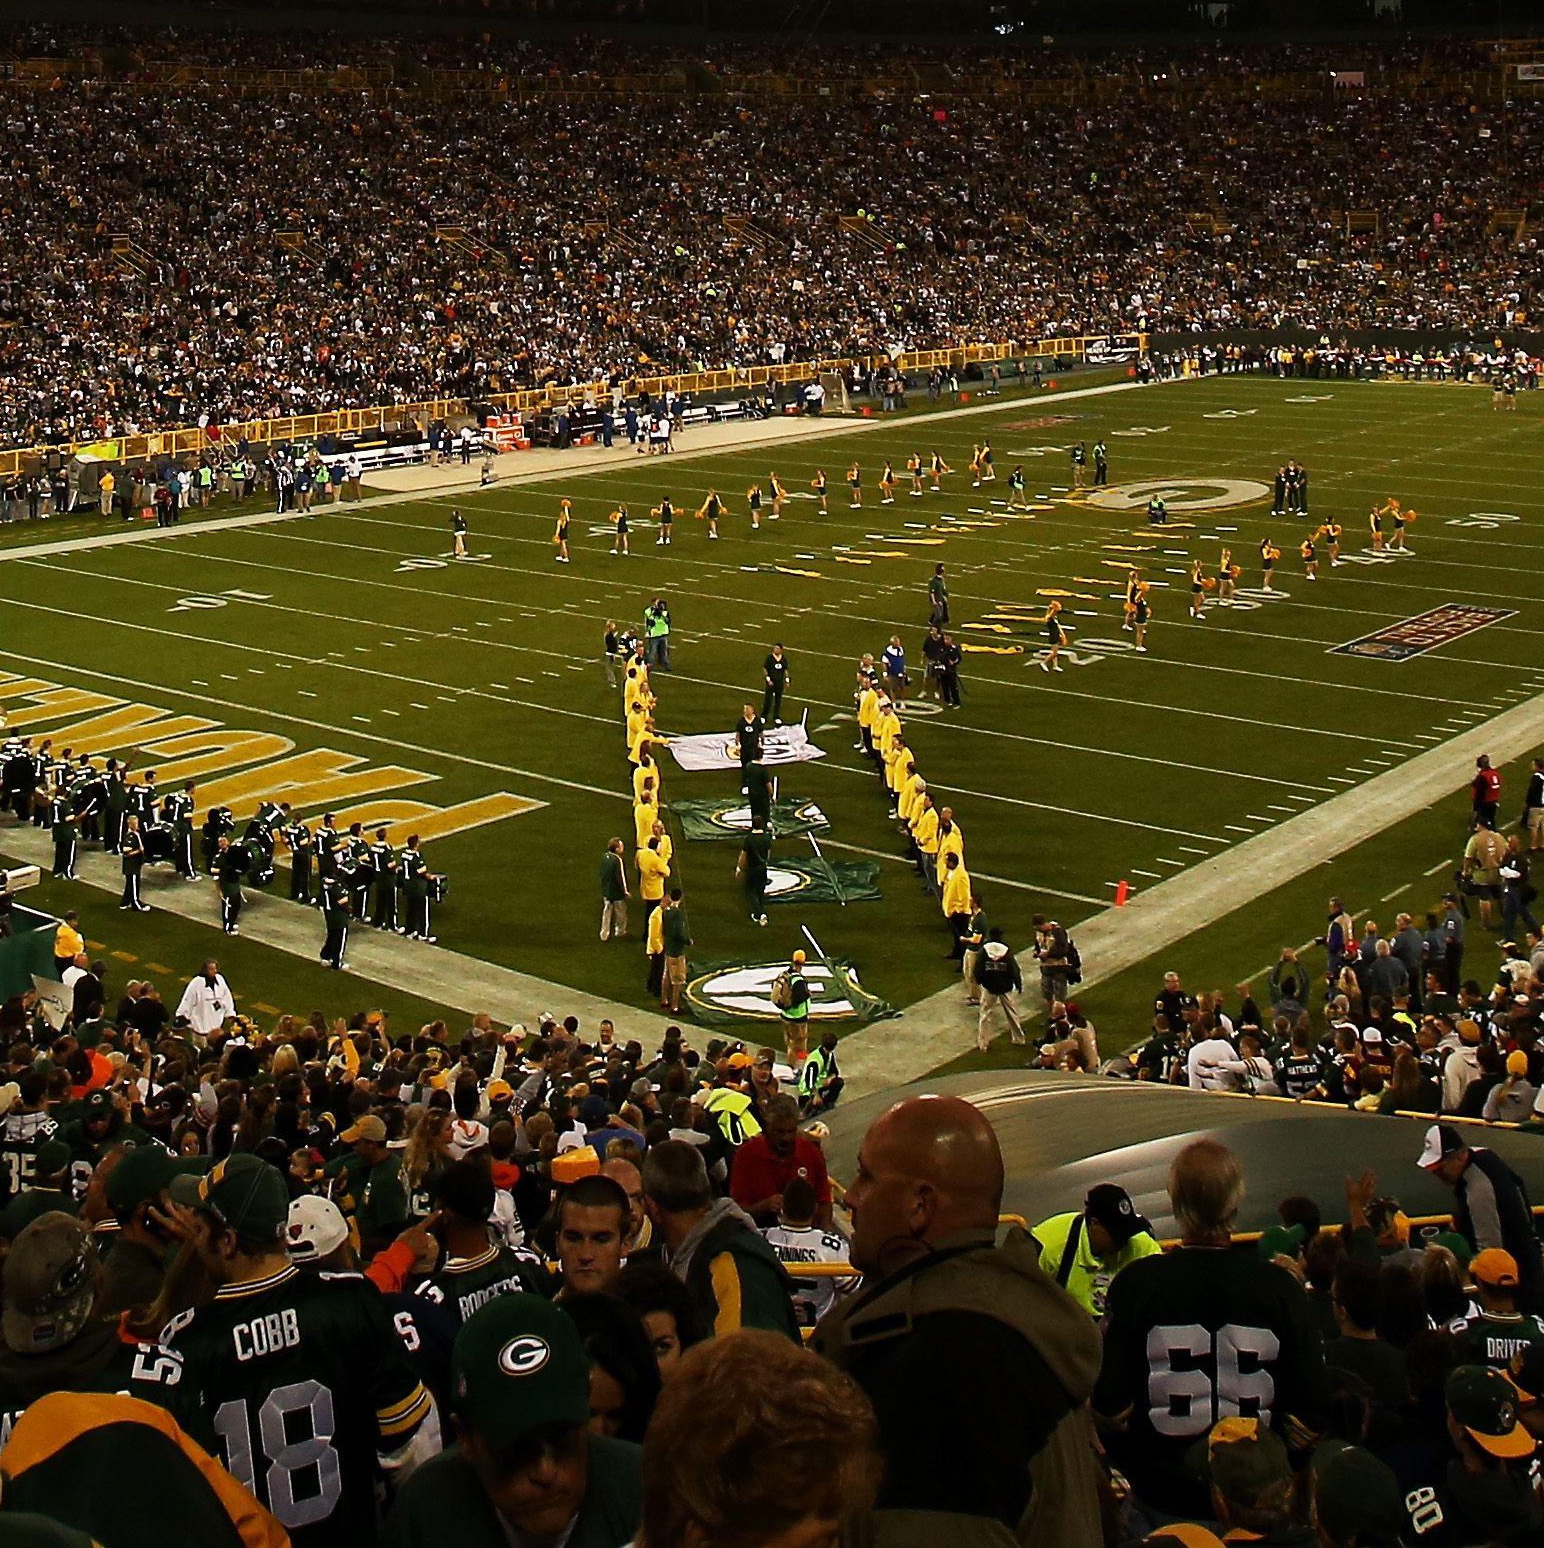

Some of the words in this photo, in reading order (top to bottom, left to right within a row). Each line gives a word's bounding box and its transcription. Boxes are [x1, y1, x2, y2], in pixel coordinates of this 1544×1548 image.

[232, 1308, 302, 1361] COBB
[498, 1335, 551, 1376] G
[1146, 1323, 1280, 1437] 66
[213, 1378, 342, 1529] 18
[1406, 1485, 1445, 1536] 80
